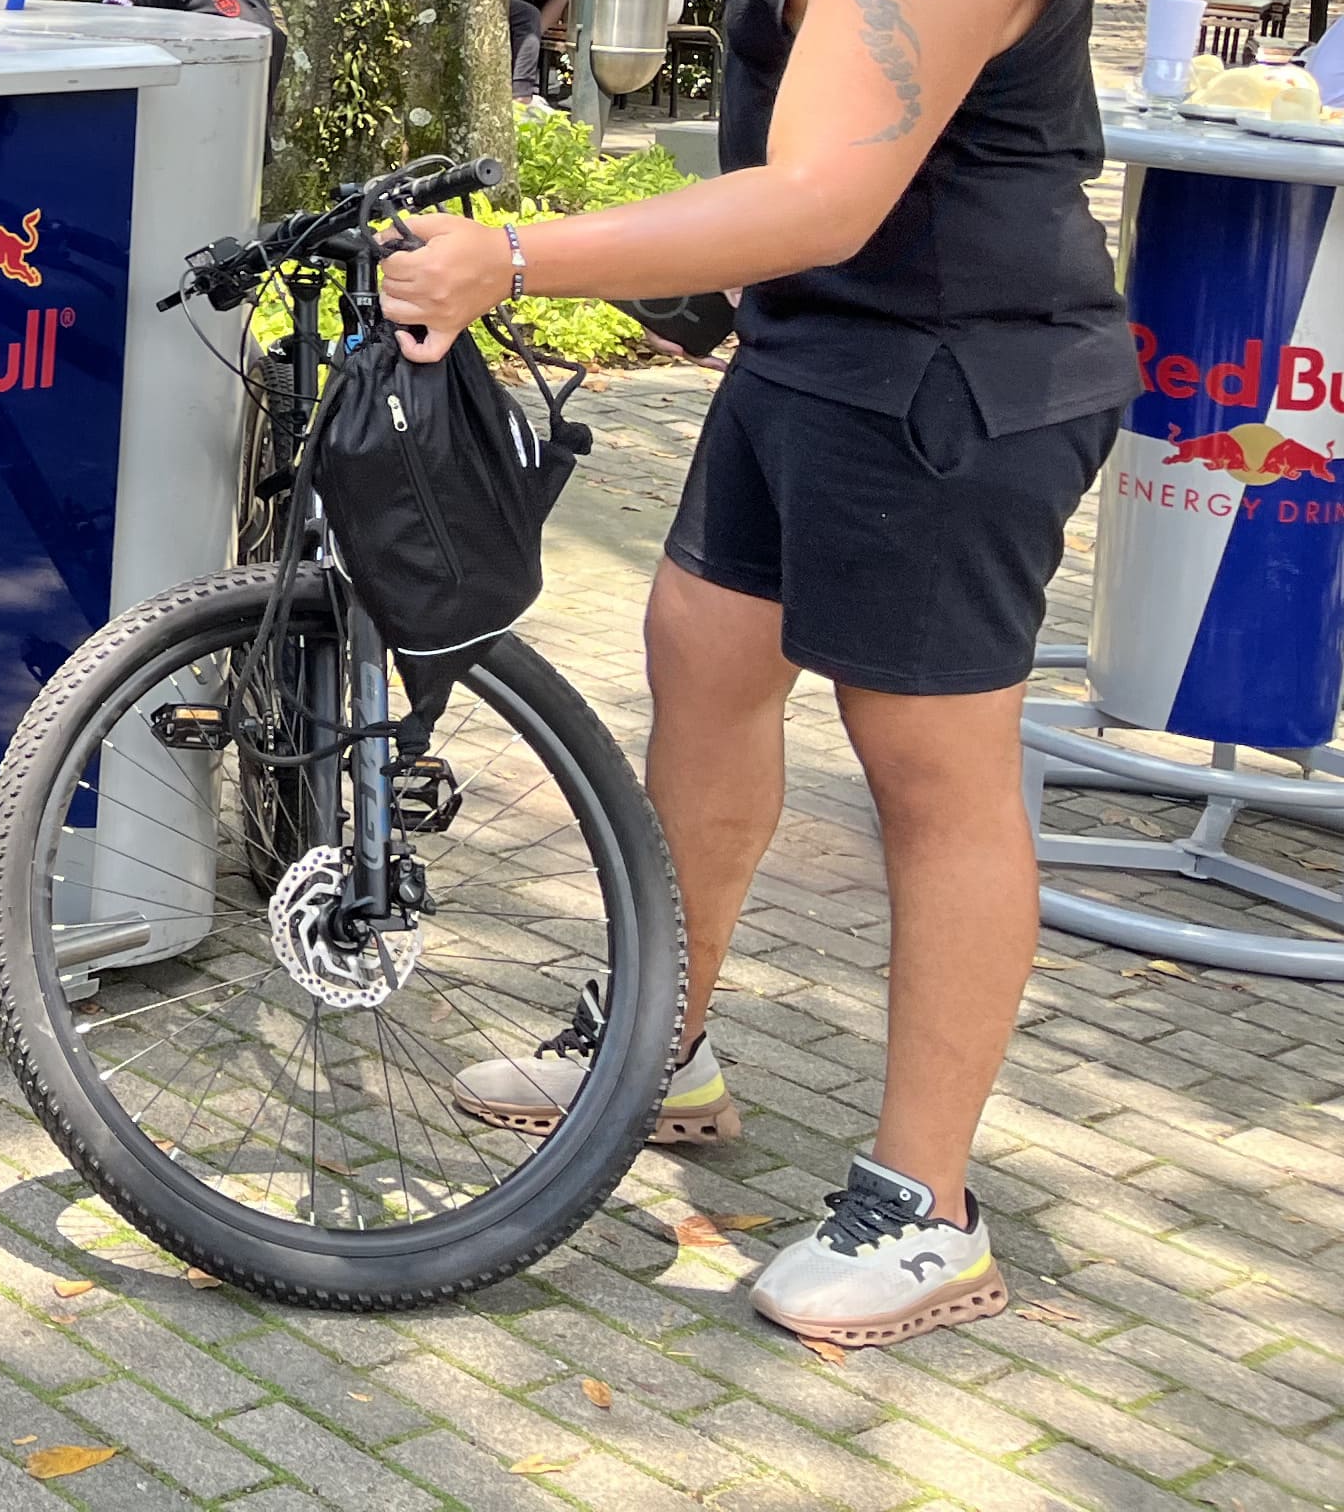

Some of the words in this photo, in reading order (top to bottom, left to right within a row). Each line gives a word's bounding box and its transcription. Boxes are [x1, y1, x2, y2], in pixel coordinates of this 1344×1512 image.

[1127, 322, 1263, 408] Red
[1276, 345, 1344, 414] Bu
[1118, 471, 1262, 520] ENERGY
[1278, 500, 1344, 525] DRIN
